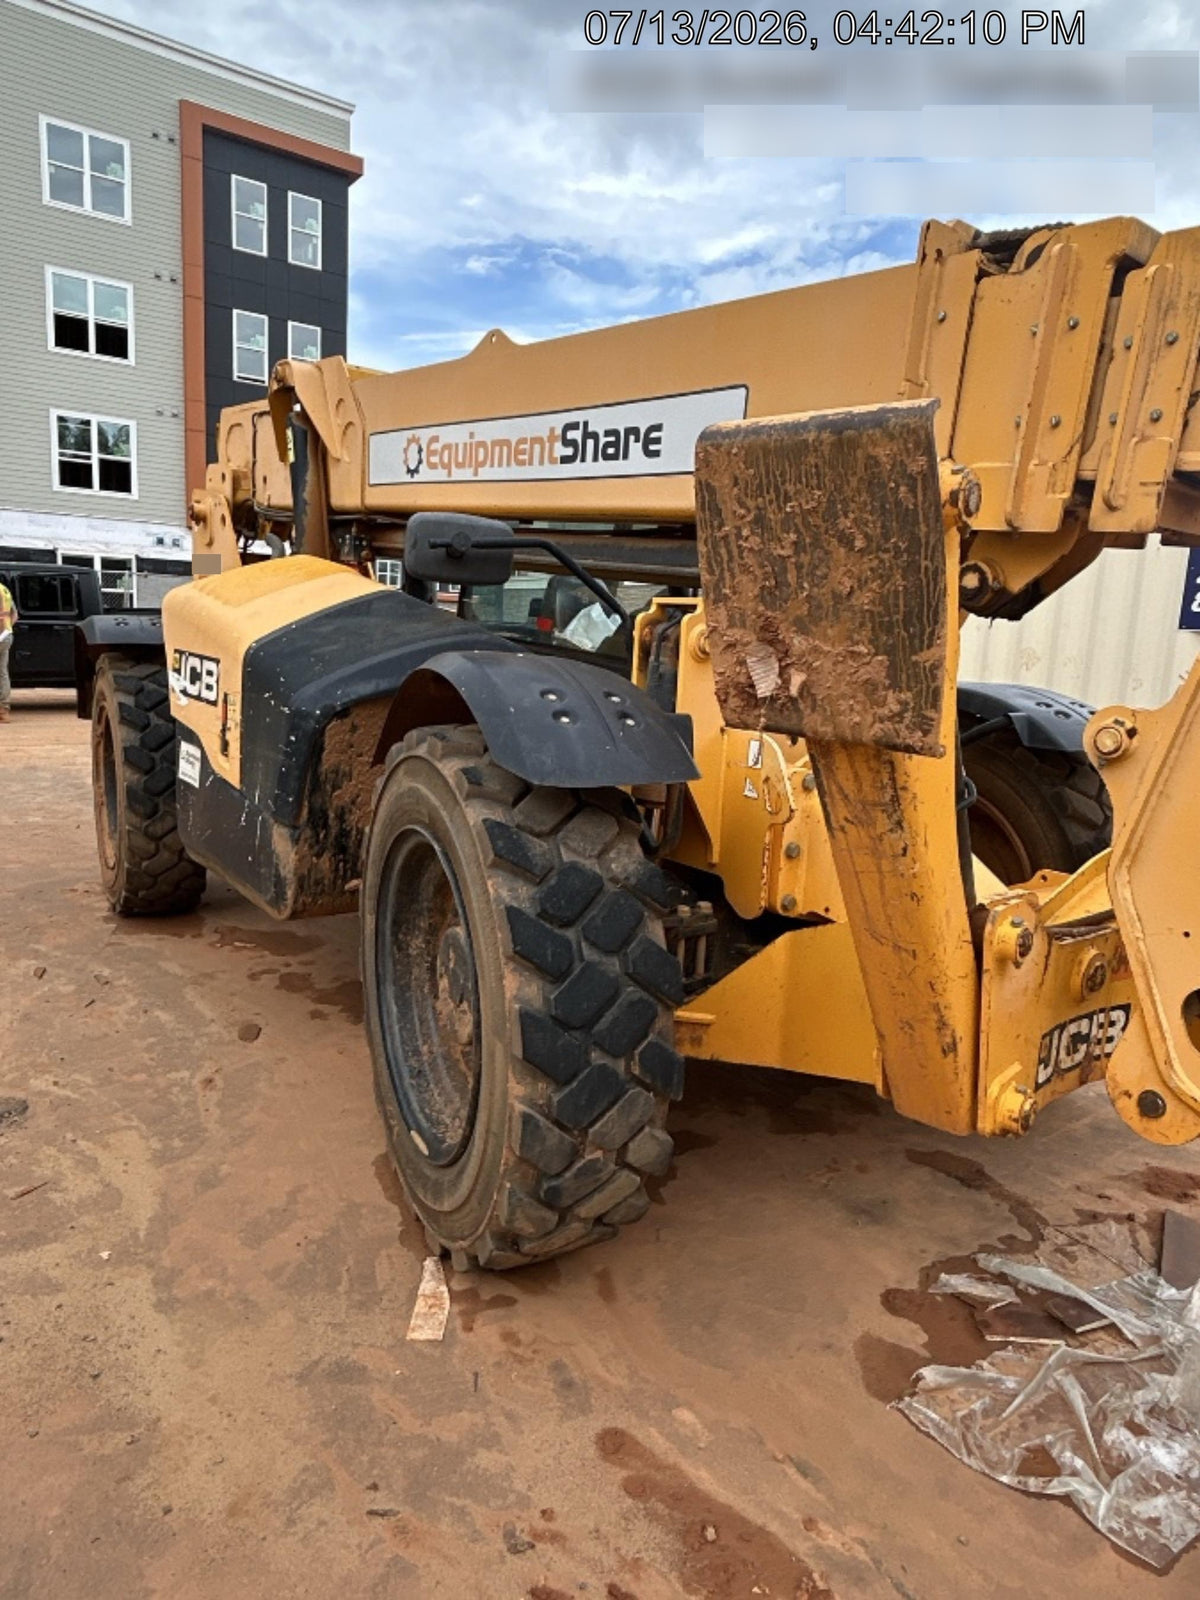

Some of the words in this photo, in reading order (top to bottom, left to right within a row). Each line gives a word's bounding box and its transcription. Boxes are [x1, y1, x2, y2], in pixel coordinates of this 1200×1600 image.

[426, 420, 664, 477] EquipmentShare
[171, 652, 219, 703] JCB
[1037, 1007, 1128, 1085] JCB
